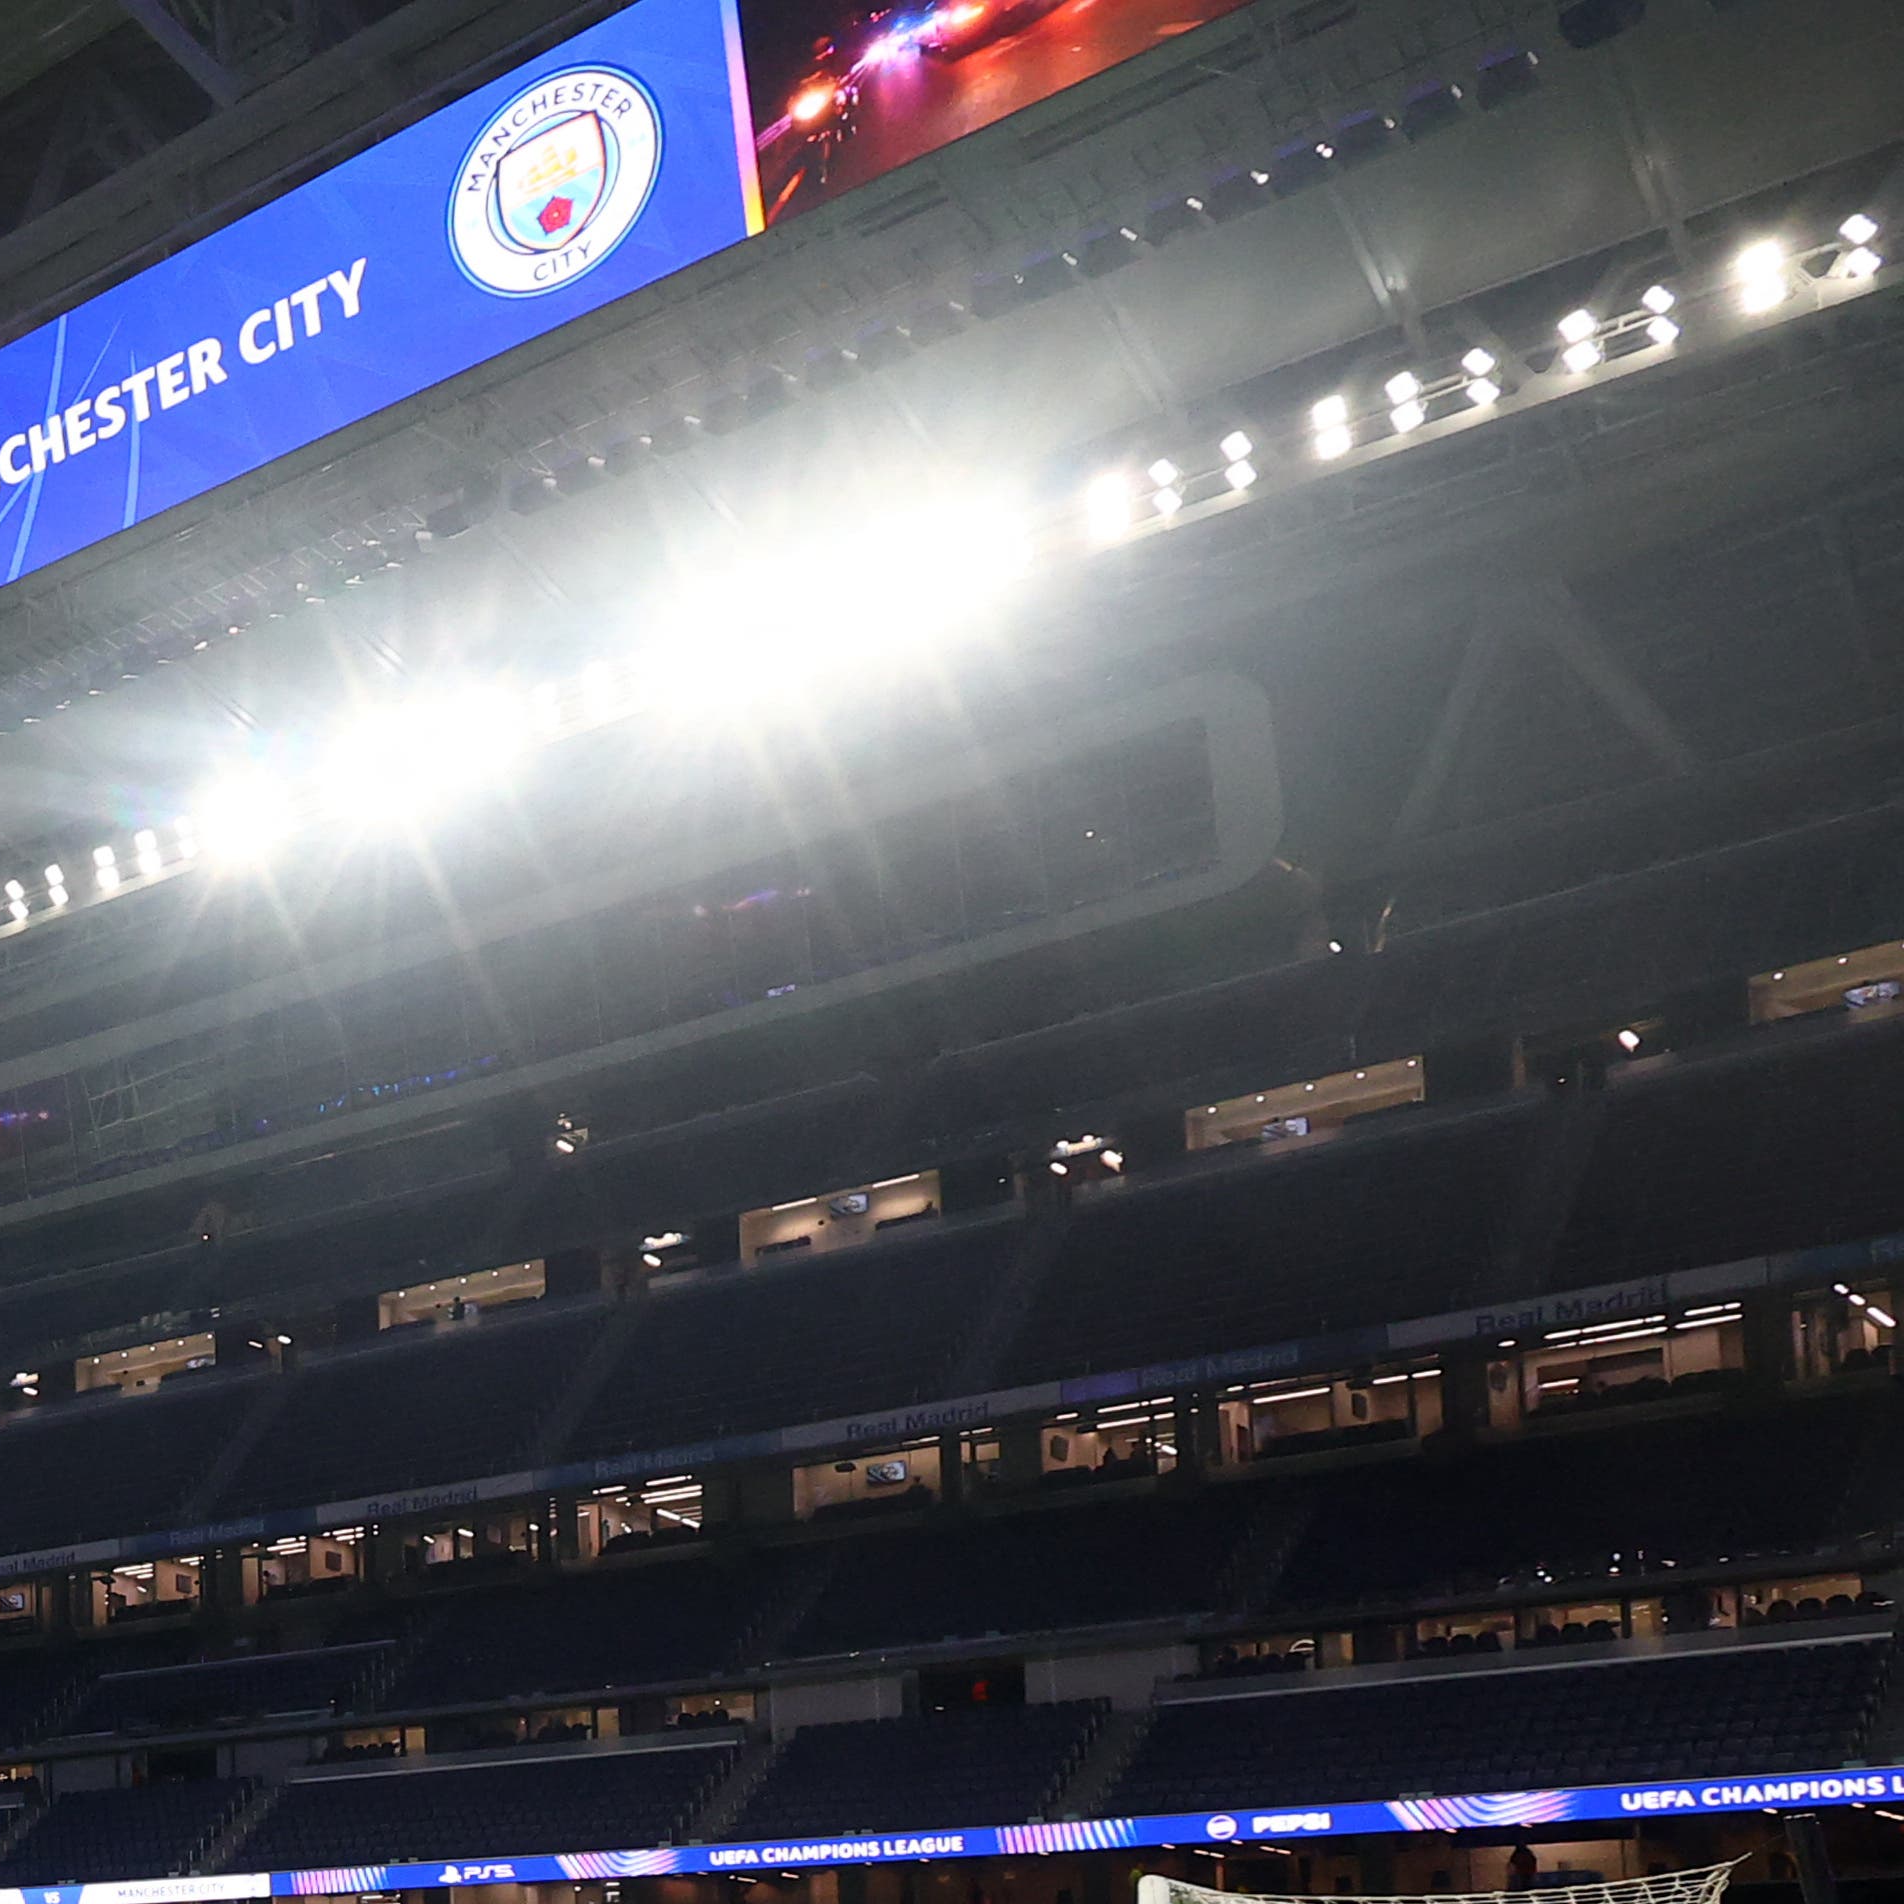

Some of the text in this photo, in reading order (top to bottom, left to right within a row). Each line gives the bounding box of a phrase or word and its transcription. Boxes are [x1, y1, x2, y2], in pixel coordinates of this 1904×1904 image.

[467, 81, 633, 193] MANCHESTER
[533, 240, 593, 282] CITY
[239, 257, 367, 365] CITY
[1475, 1282, 1665, 1335] Real Madrid
[846, 1401, 989, 1440] Real Madrid
[368, 1487, 477, 1516] Real Madrid
[170, 1520, 264, 1544] Real Madrid
[24, 1552, 75, 1569] Madrid
[1621, 1790, 1696, 1811] UEFA
[1701, 1776, 1886, 1807] CHAMPIONS
[1252, 1812, 1331, 1834] PEPSI
[709, 1835, 964, 1866] UEFA CHAMPIONS LEAGUE
[463, 1864, 516, 1880] PS5
